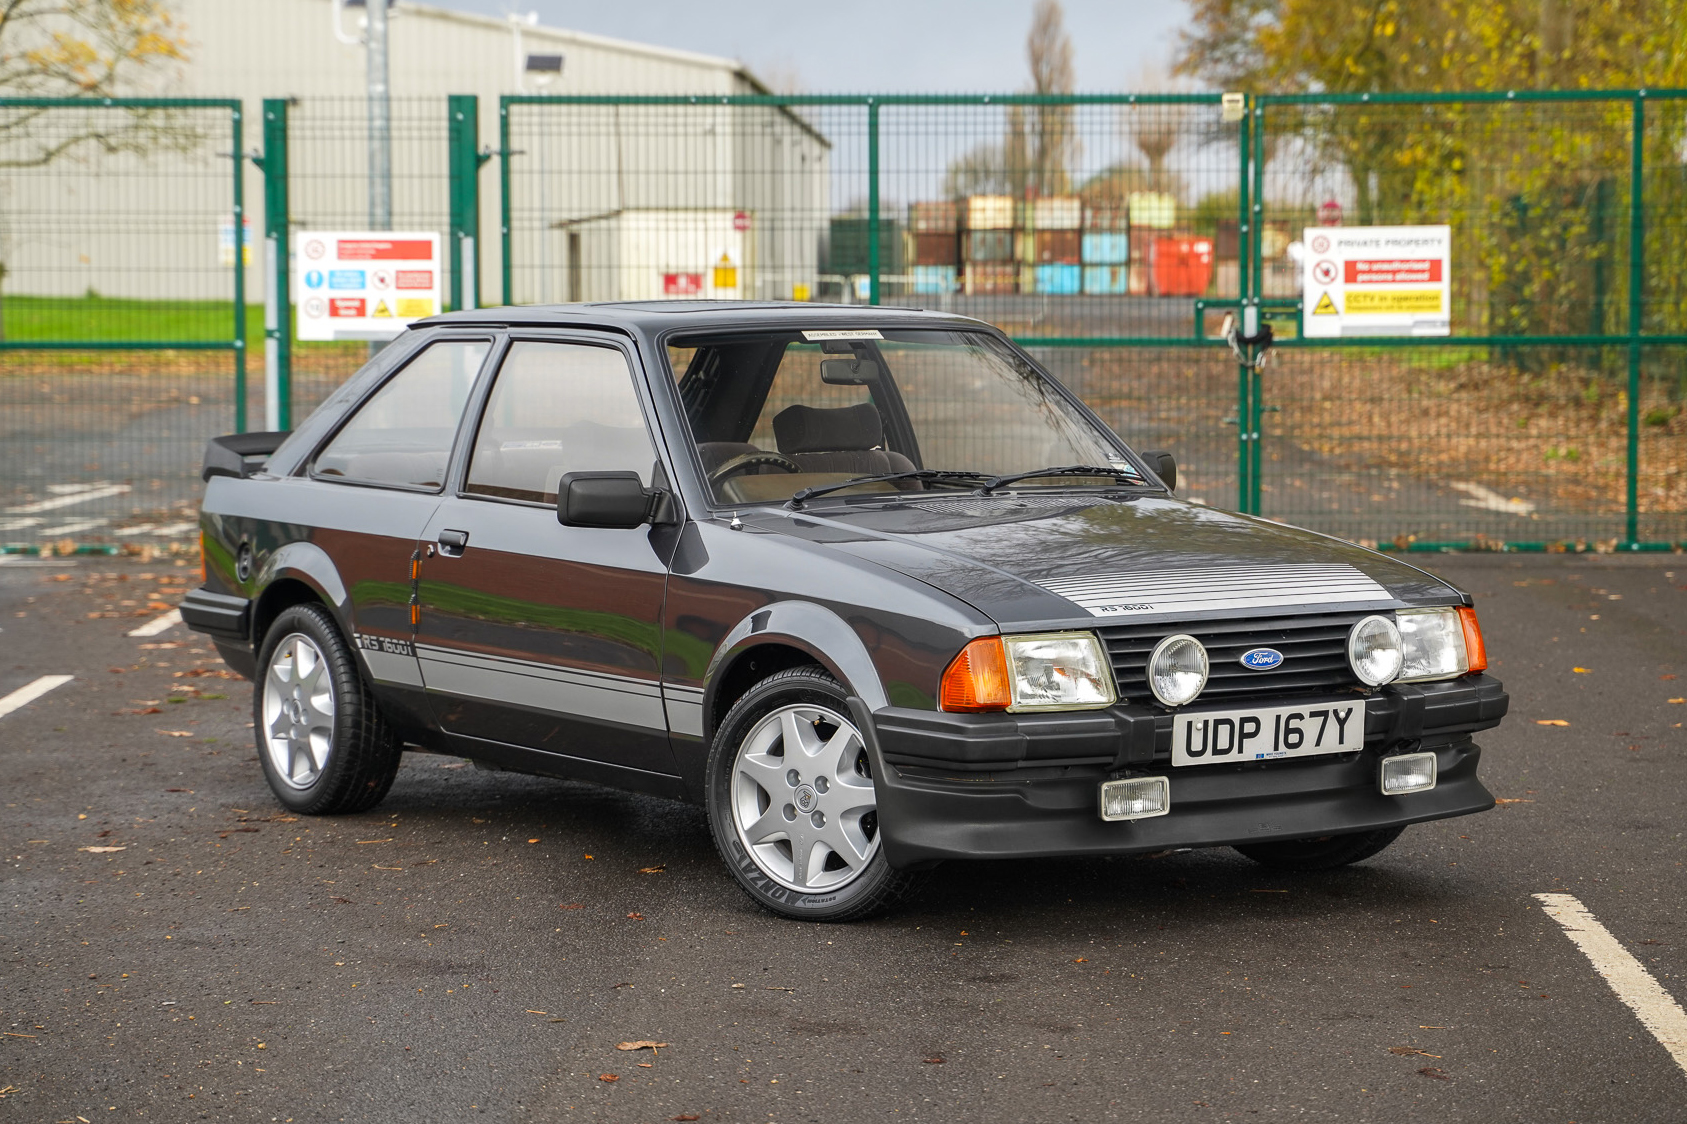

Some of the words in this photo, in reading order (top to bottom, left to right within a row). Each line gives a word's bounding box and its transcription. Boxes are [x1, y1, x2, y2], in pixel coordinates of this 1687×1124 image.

[1338, 239, 1381, 248] PRIVATE
[1385, 238, 1443, 247] PROPERTY
[1356, 262, 1370, 271] No
[1356, 273, 1393, 283] persons
[1394, 271, 1430, 281] allowed
[1346, 293, 1376, 303] CCTV
[1379, 294, 1388, 302] in
[1391, 294, 1440, 304] operation
[362, 634, 379, 650] RS
[1252, 652, 1274, 664] Ford
[1186, 716, 1261, 758] UDP
[1273, 708, 1354, 752] 167Y
